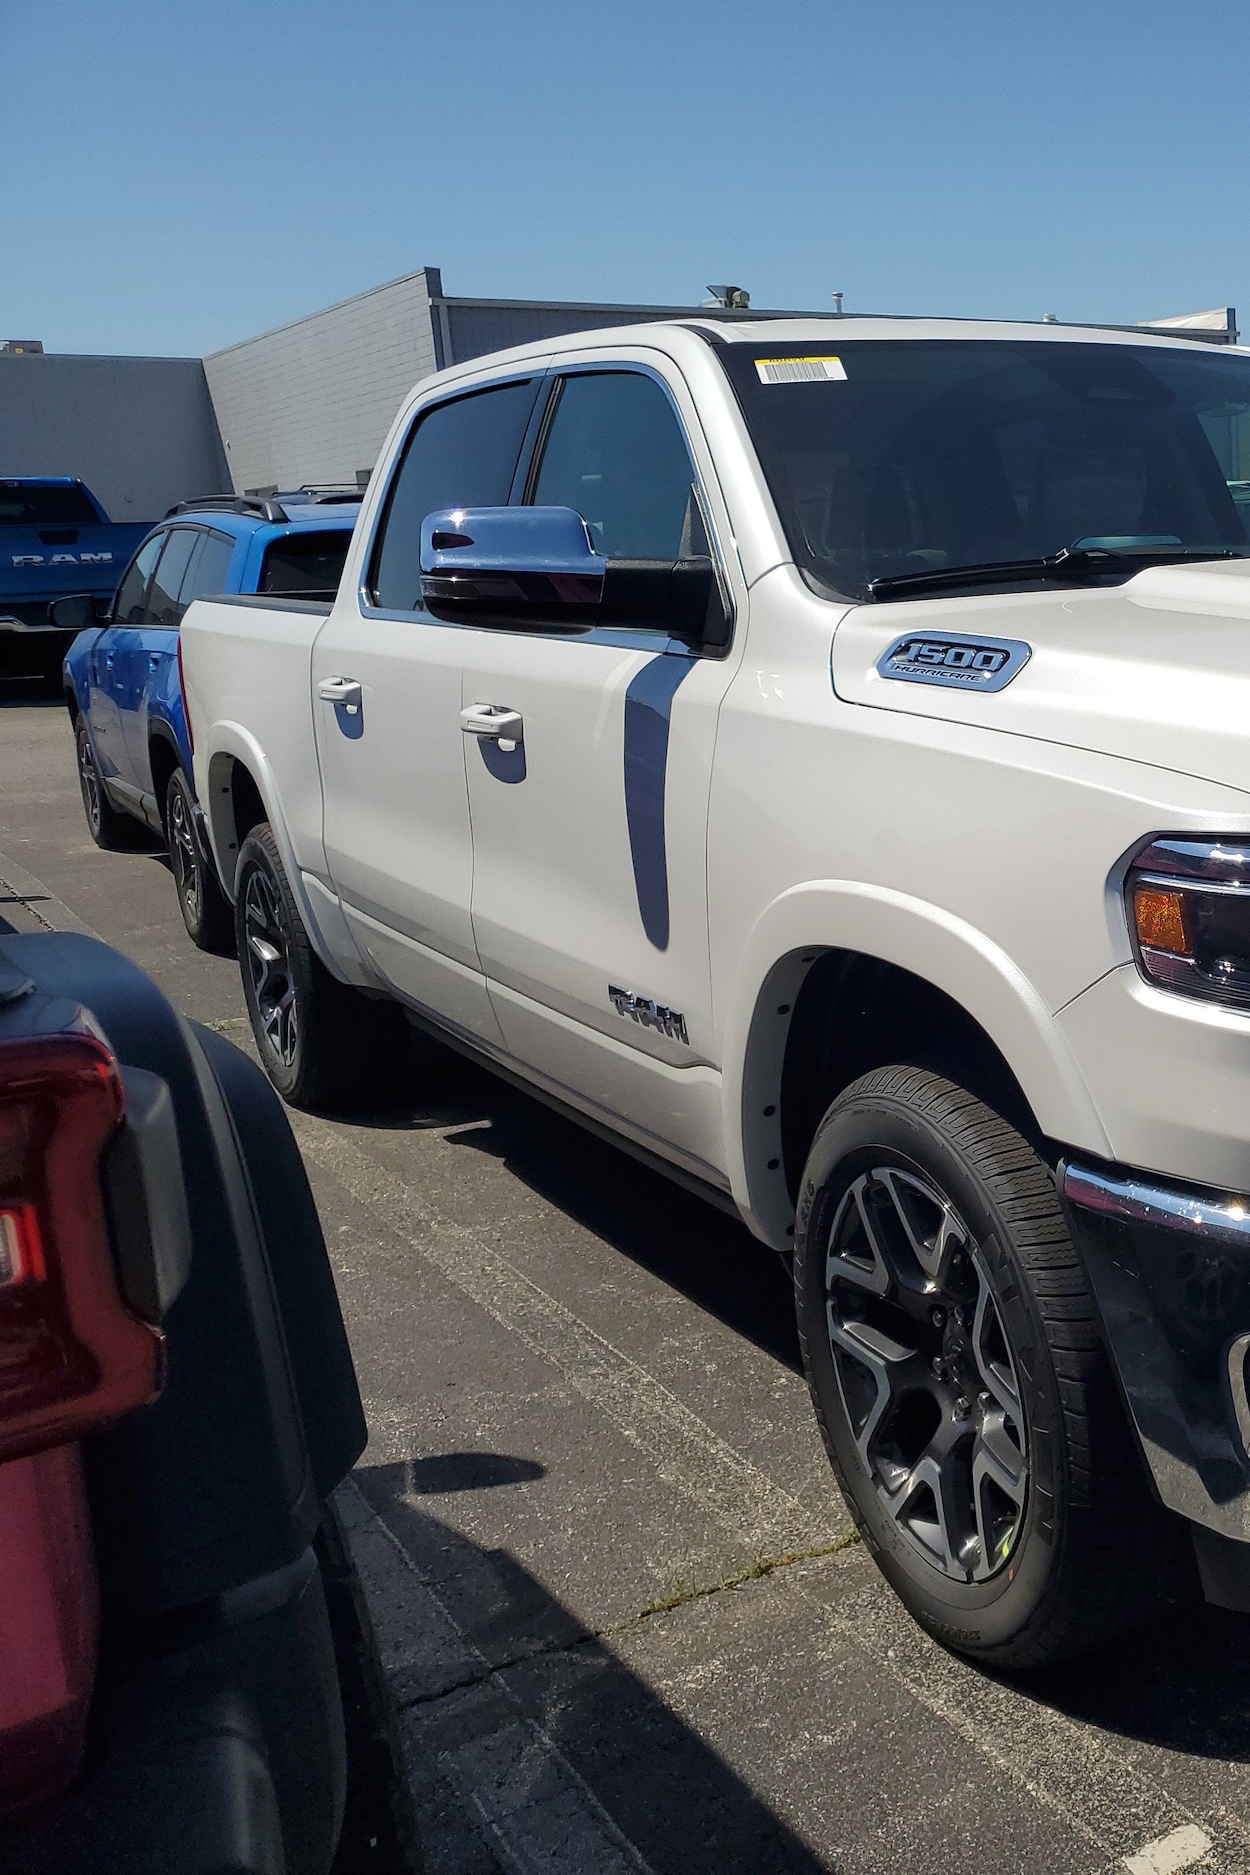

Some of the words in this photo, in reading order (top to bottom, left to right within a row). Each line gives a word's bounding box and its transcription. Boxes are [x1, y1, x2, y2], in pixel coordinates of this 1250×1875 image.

[11, 552, 113, 567] RAM
[904, 642, 1005, 672] 1500
[894, 664, 982, 682] HURRICANE
